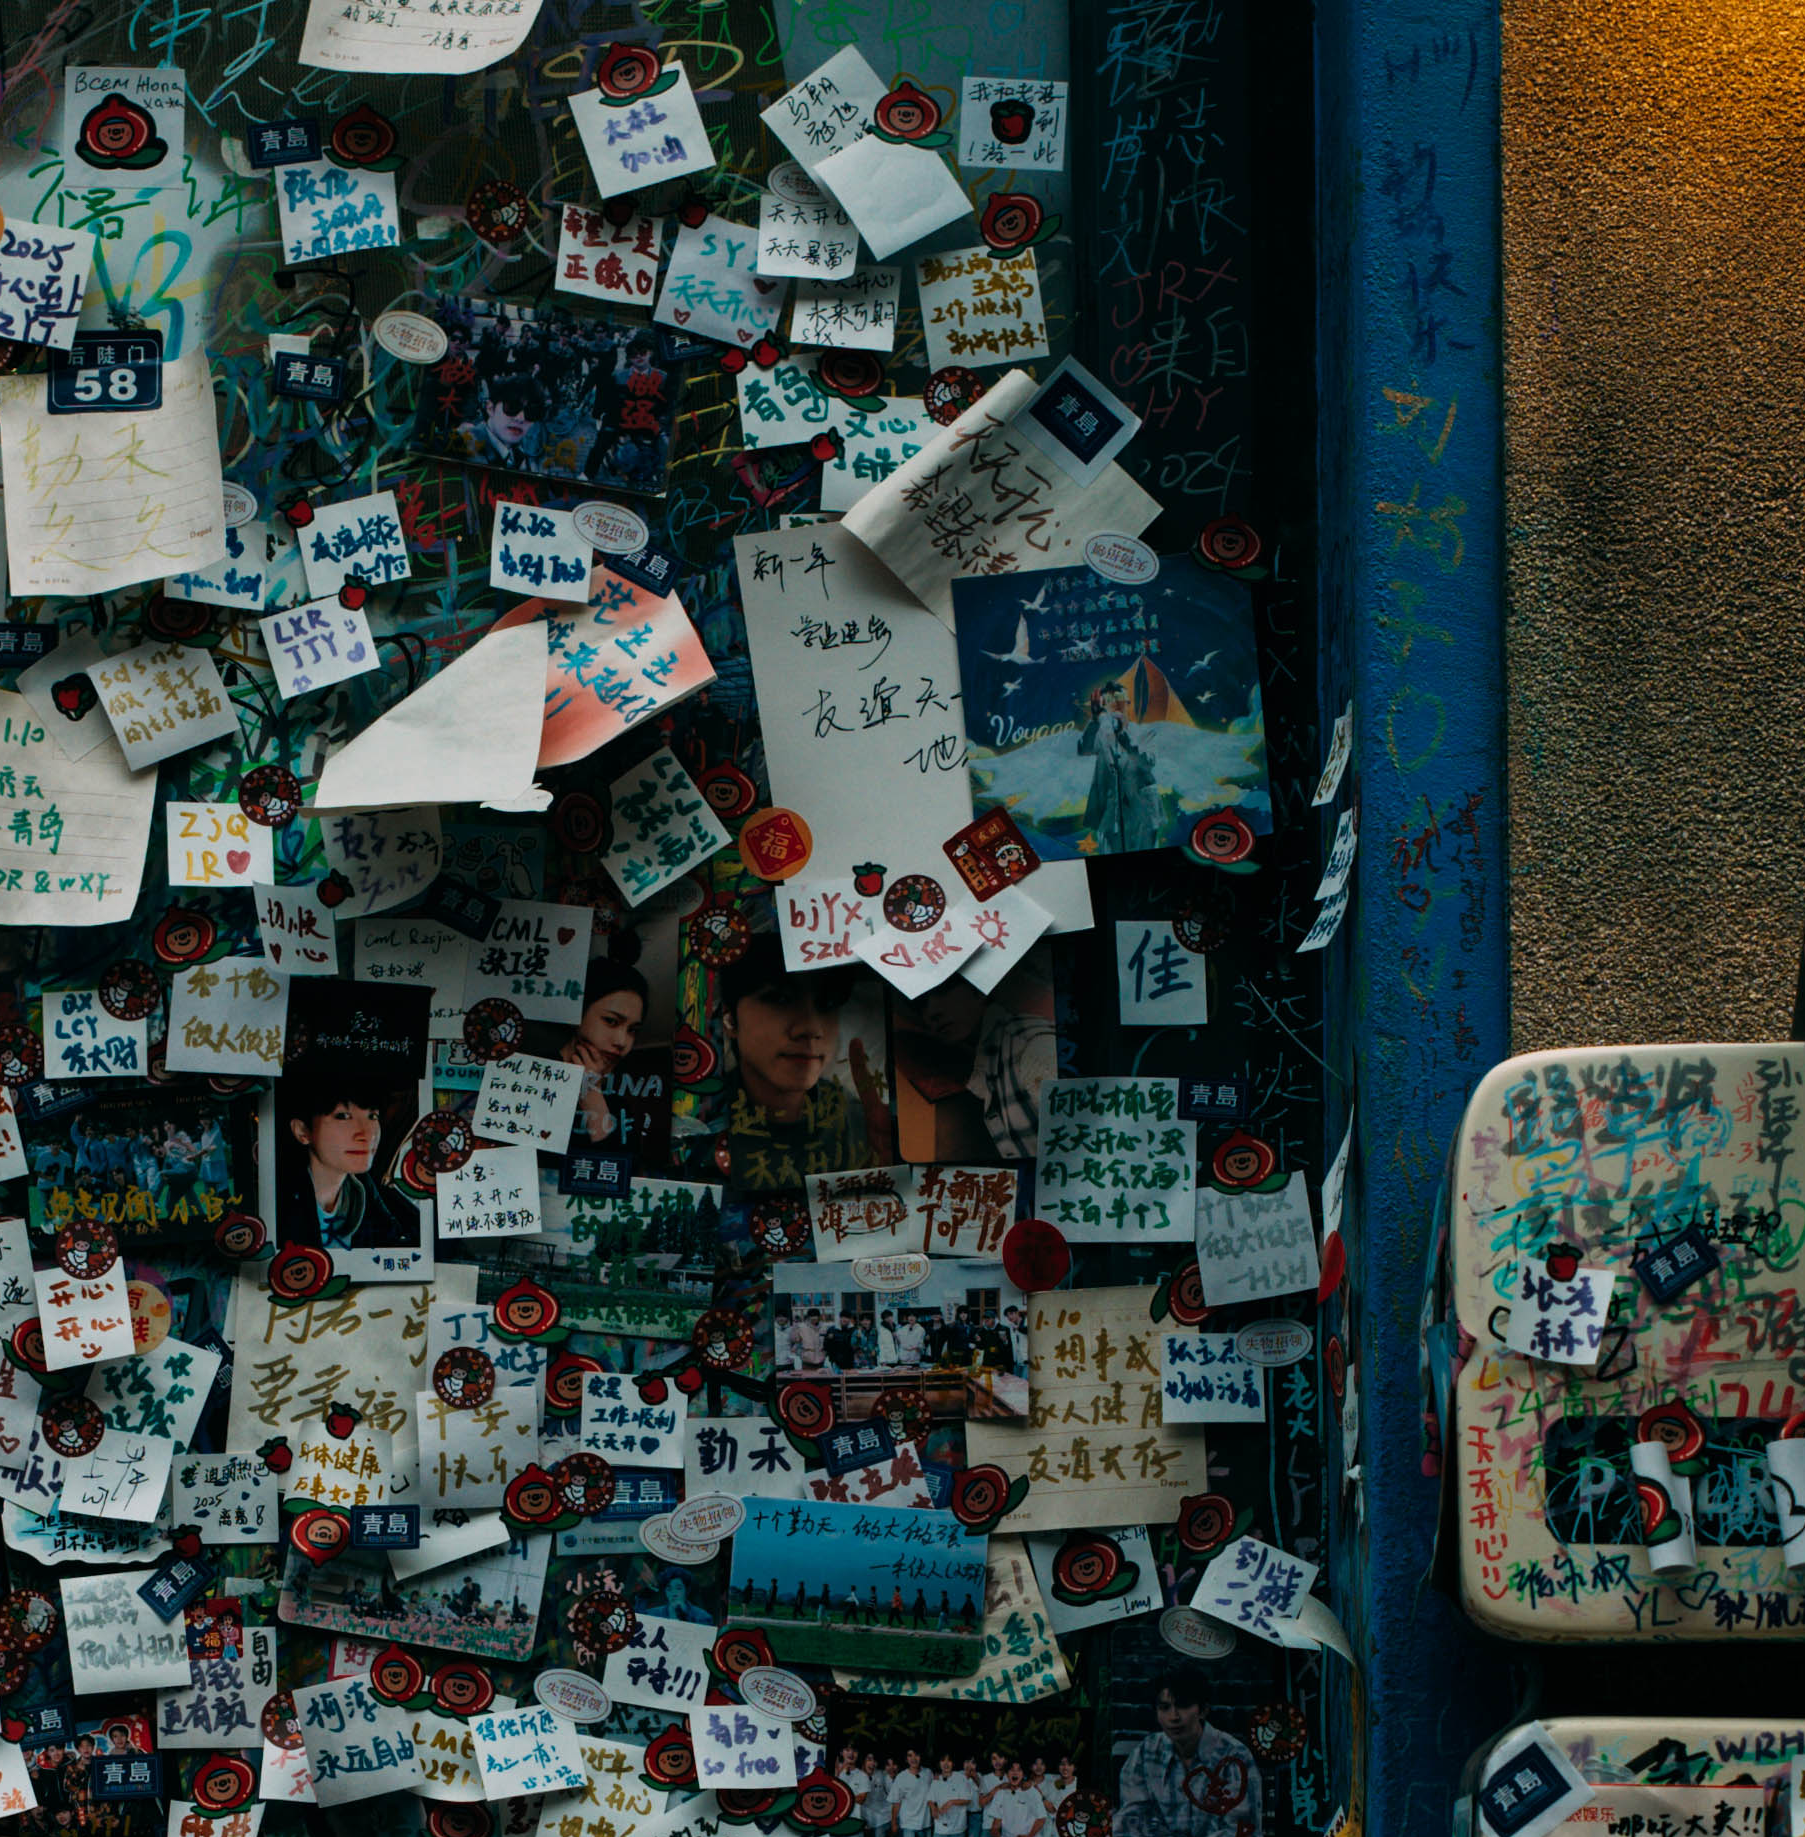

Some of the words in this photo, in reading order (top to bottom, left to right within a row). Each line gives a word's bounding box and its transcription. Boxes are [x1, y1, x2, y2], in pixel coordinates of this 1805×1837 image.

[261, 127, 309, 150] 青島
[74, 368, 137, 403] 58
[286, 361, 334, 384] 青島
[992, 714, 1076, 749] Voyage
[761, 828, 789, 858] 福
[1191, 1081, 1237, 1108] 青島
[572, 1158, 621, 1183] 青島
[1651, 1245, 1699, 1281] 青島
[361, 1512, 409, 1534] 青島
[103, 1759, 151, 1784] 青島
